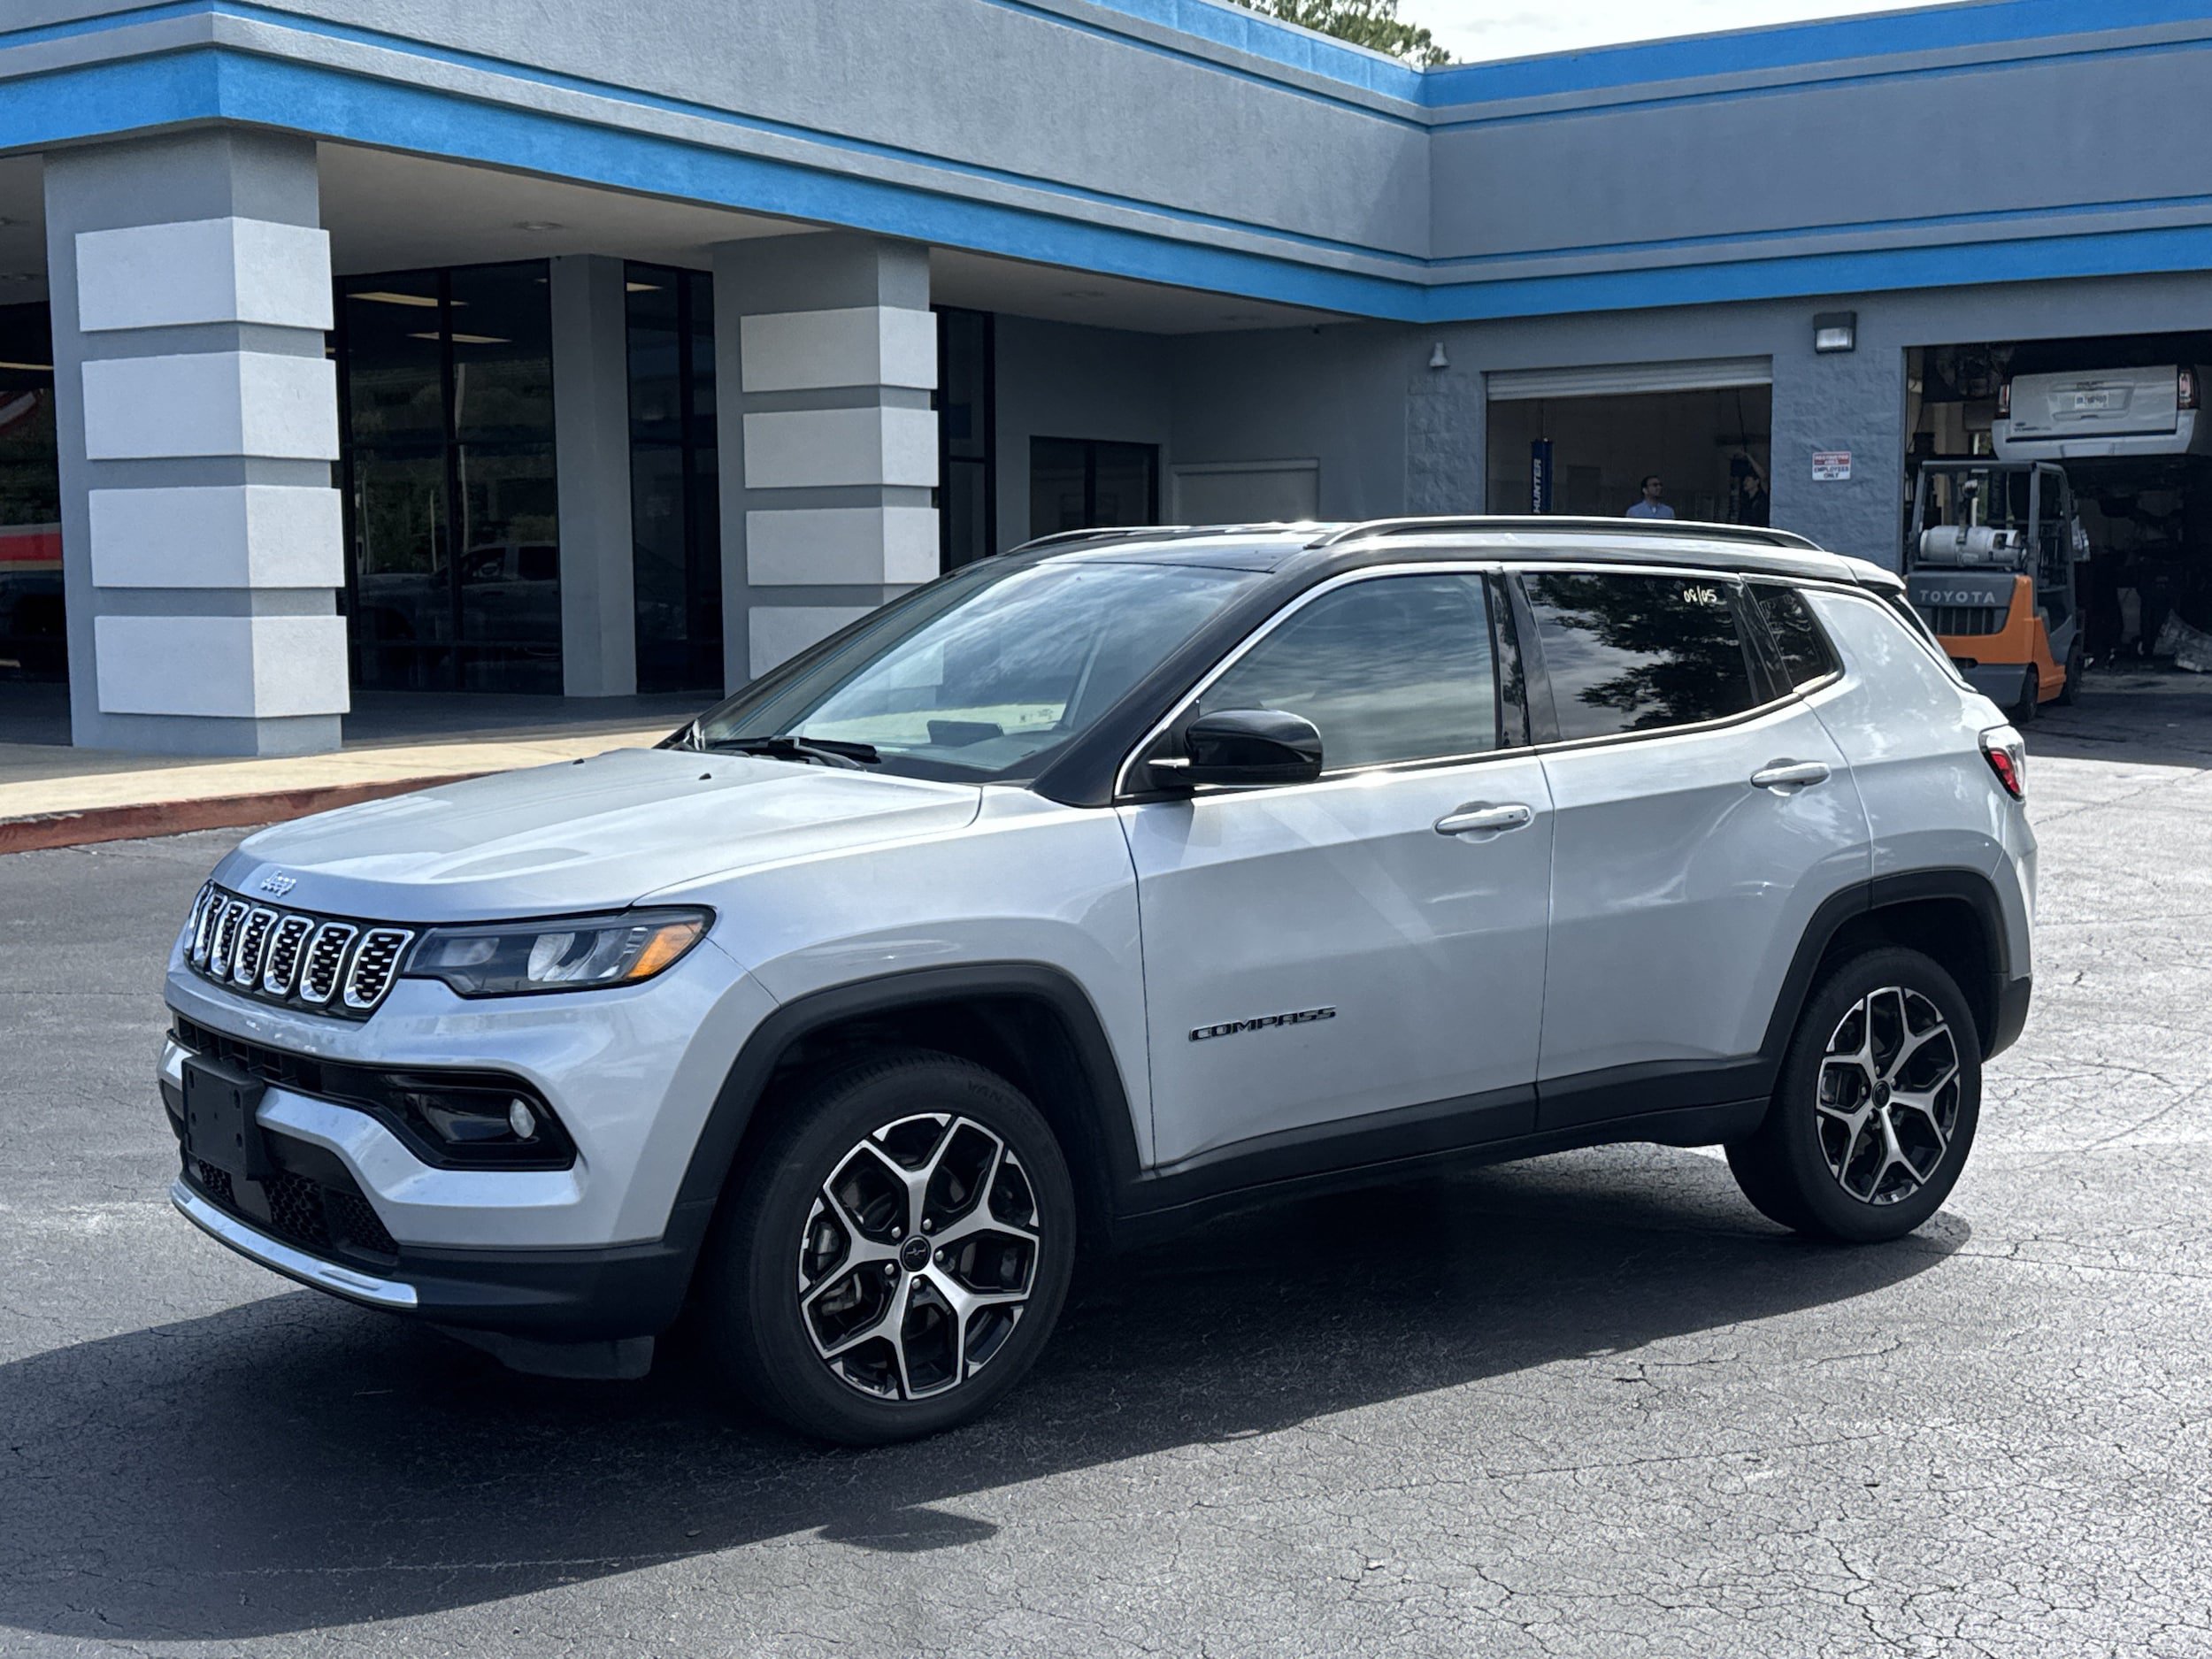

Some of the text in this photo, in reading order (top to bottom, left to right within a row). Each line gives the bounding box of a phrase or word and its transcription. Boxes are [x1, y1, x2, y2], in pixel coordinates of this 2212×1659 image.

[1533, 458, 1542, 514] HUNTER
[1919, 589, 1996, 603] TOYOTA
[260, 870, 296, 898] Jeep
[1188, 1005, 1337, 1042] COMPASS
